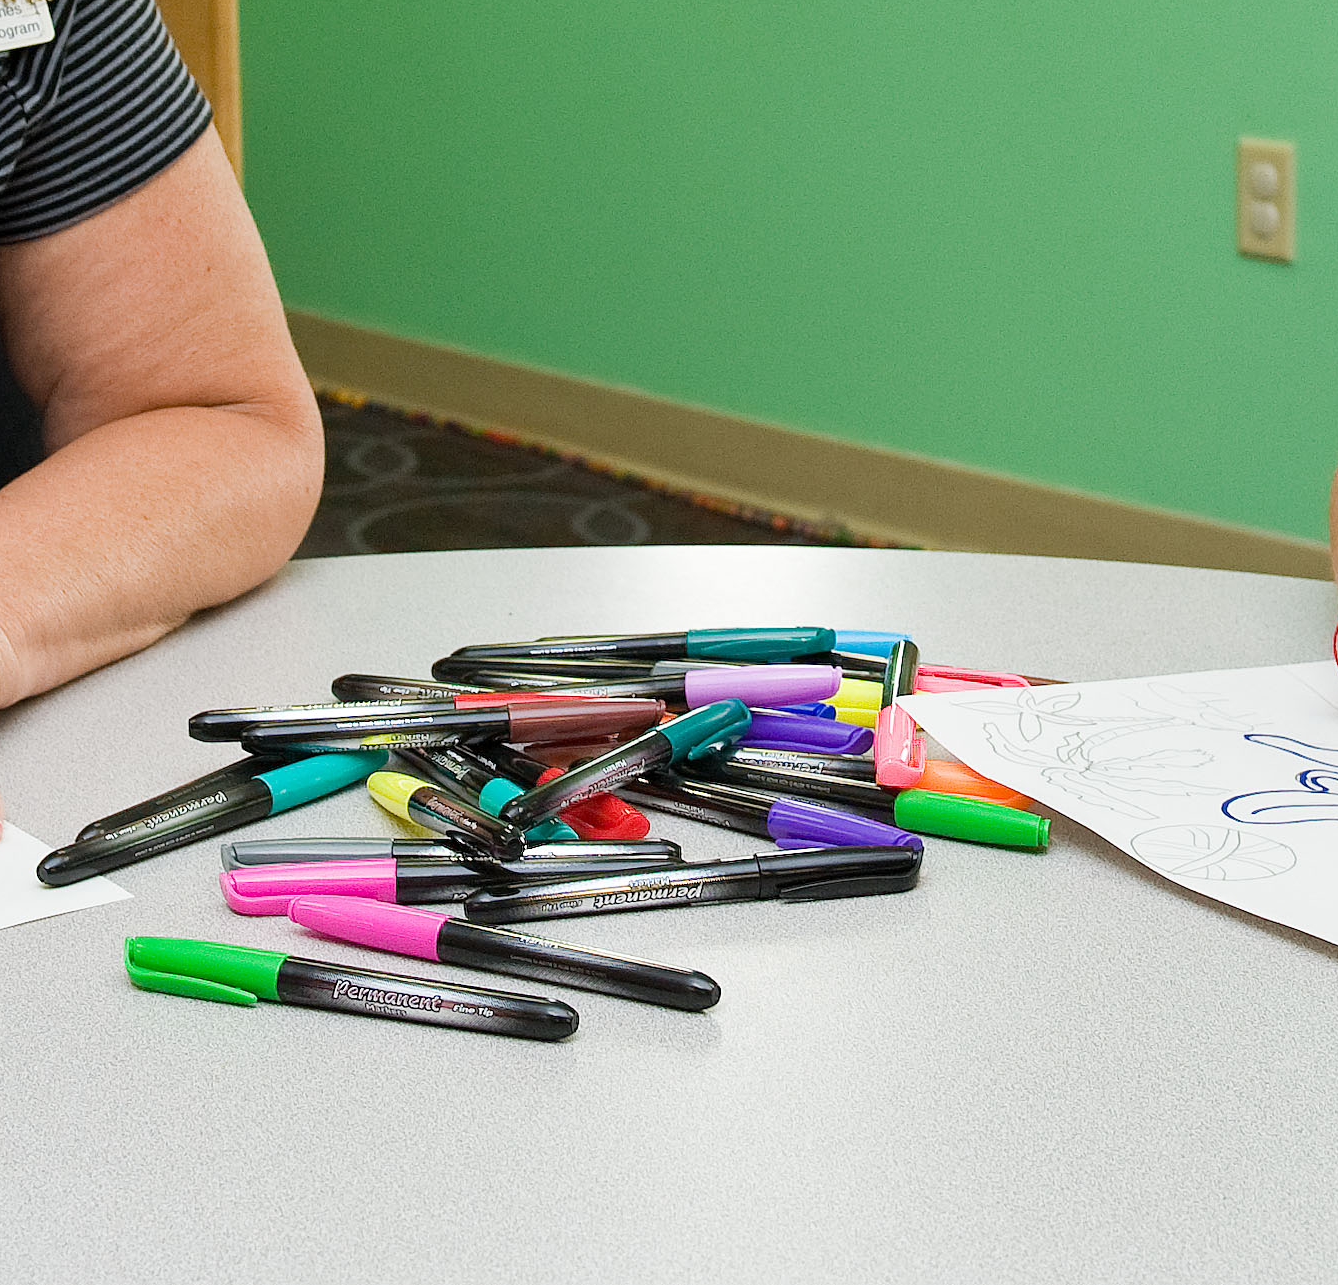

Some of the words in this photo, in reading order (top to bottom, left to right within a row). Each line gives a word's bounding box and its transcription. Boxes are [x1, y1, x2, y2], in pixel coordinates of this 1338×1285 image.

[144, 790, 228, 830] Permanent
[592, 884, 704, 909] Permanent
[332, 978, 443, 1013] Permanent
[451, 1003, 477, 1015] Fine
[477, 1007, 495, 1019] Tip
[364, 1002, 408, 1017] Markers
